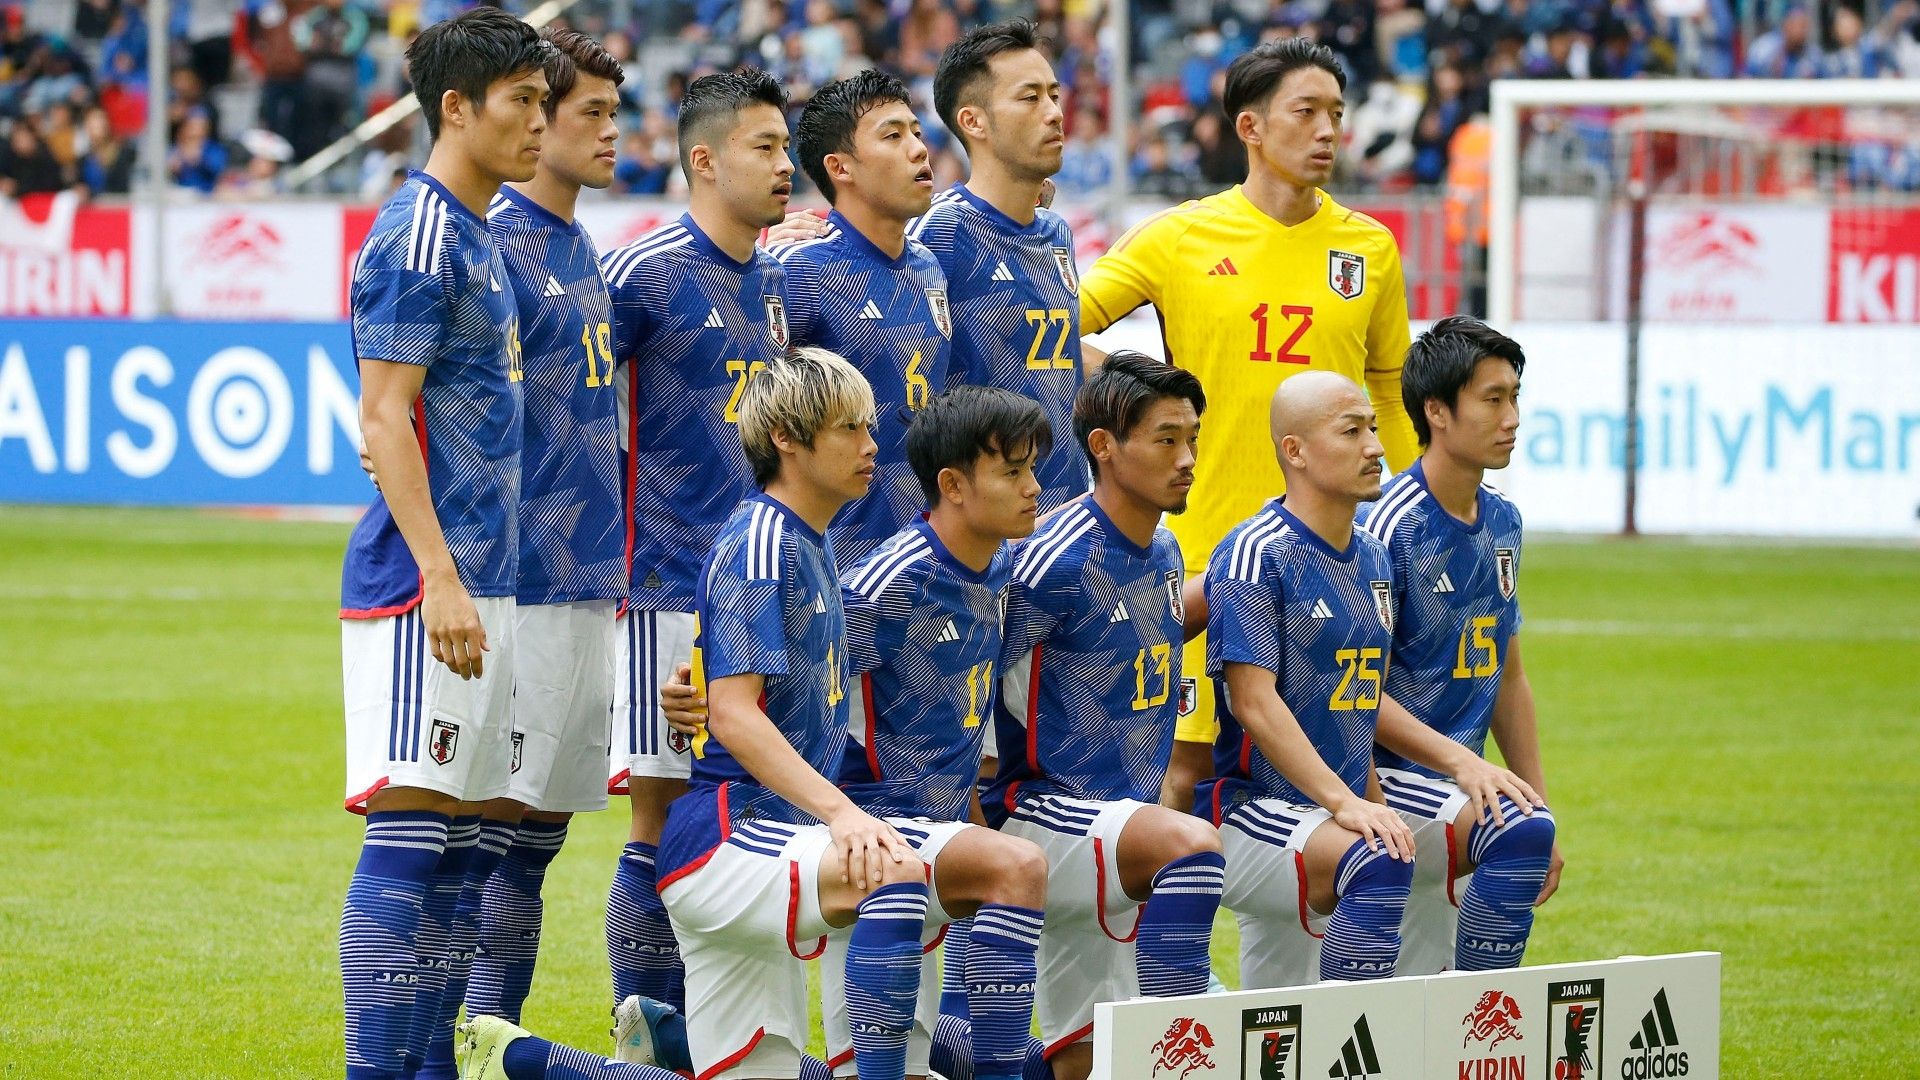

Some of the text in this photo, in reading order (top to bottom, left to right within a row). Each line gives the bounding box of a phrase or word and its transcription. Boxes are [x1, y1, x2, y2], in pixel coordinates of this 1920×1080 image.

[581, 323, 614, 387] 19
[1026, 309, 1074, 370] 22
[1250, 303, 1313, 364] 12
[725, 361, 767, 423] 2
[905, 350, 928, 411] 6
[1131, 642, 1171, 711] 13
[1452, 616, 1497, 679] 15
[963, 661, 993, 728] 11
[1329, 647, 1382, 711] 25
[1256, 1009, 1288, 1024] JAPAN
[1560, 983, 1592, 997] JAPAN
[1458, 1055, 1526, 1080] KIRIN
[1621, 1046, 1689, 1080] adidas
